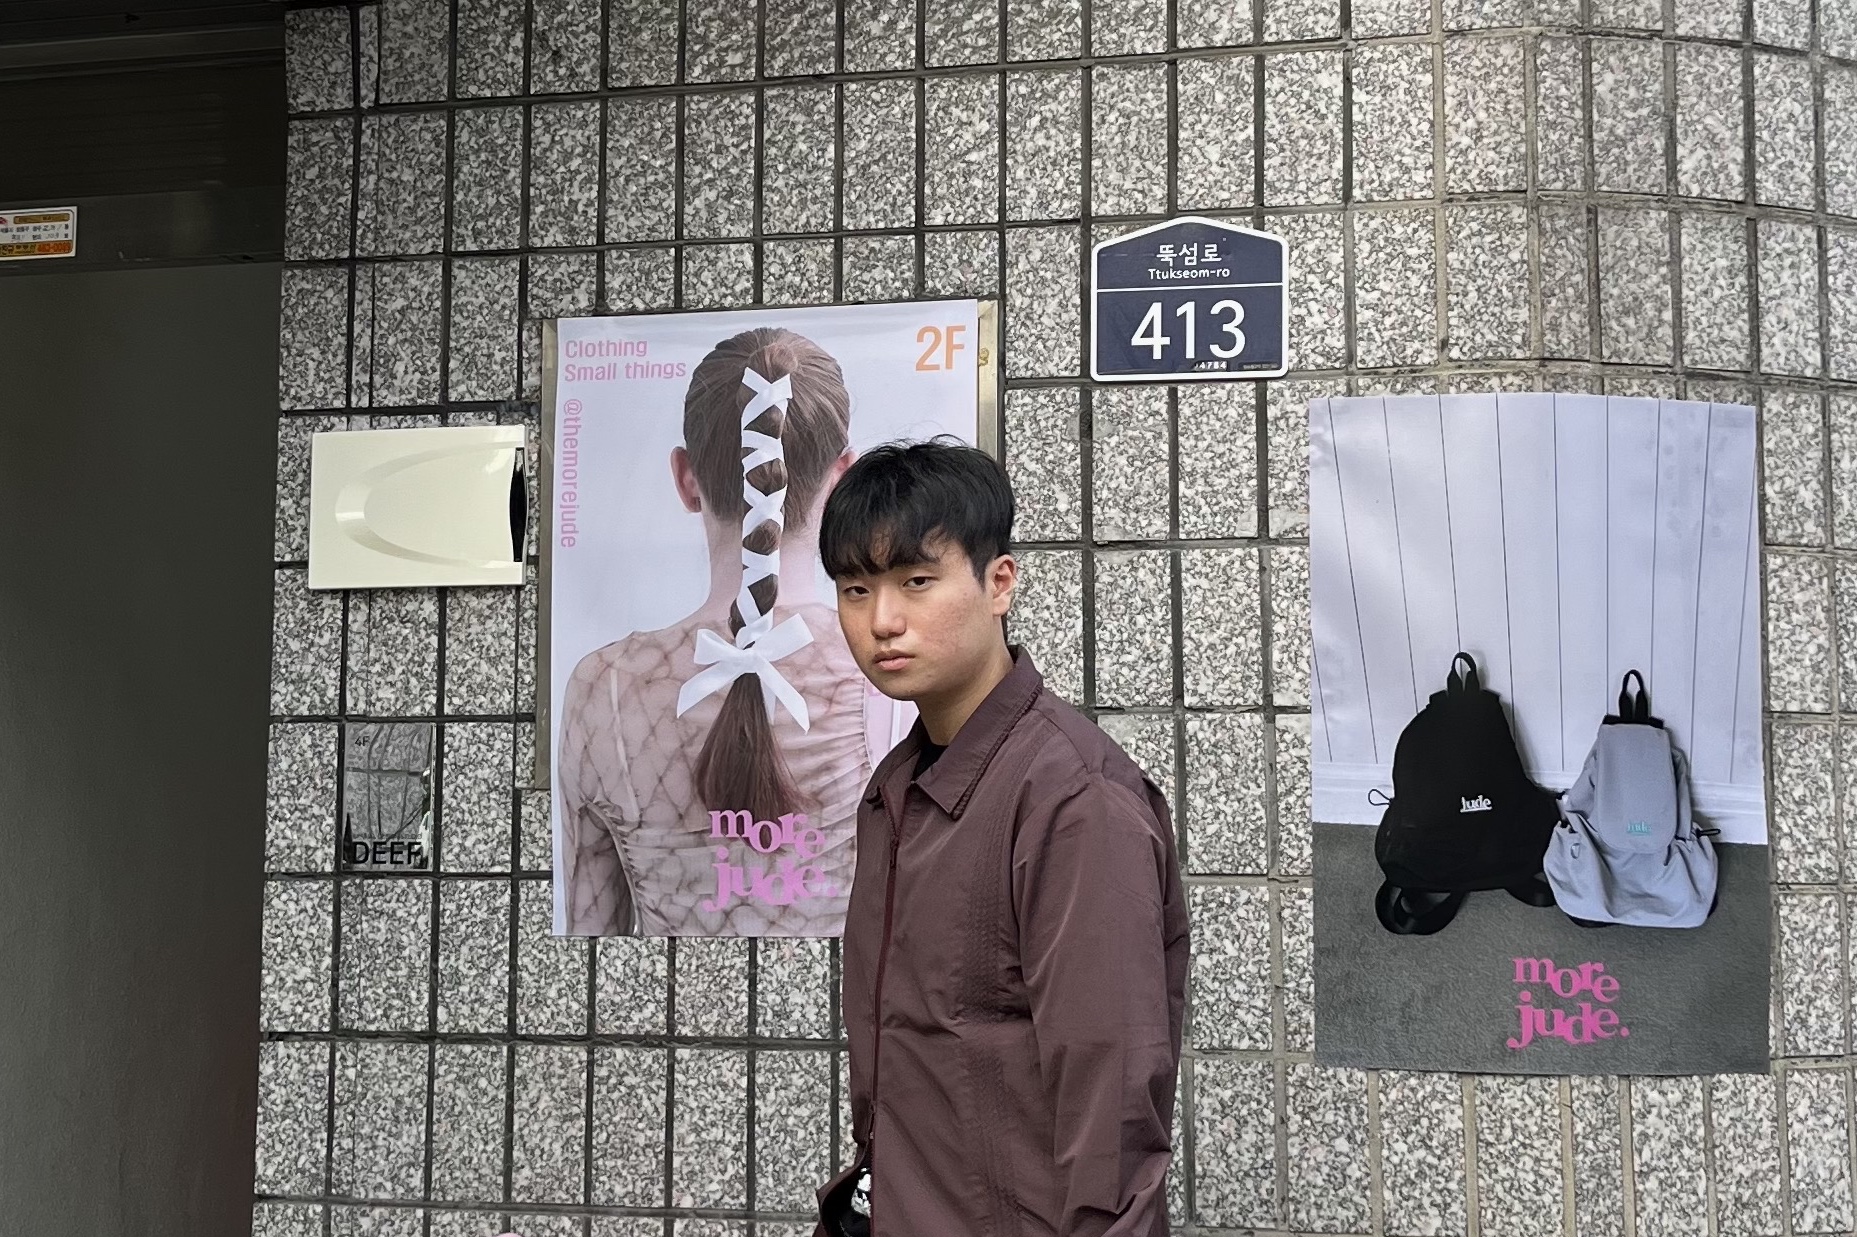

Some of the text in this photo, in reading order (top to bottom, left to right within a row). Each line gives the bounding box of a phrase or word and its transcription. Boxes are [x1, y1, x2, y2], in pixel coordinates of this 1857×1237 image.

[1148, 268, 1231, 280] Ttukseom-ro
[1156, 243, 1222, 267] 뚝섬로
[564, 339, 648, 359] Clothing
[915, 325, 967, 372] 2F
[1130, 299, 1246, 360] 413
[564, 361, 687, 382] Small things
[560, 399, 583, 548] @themorejude
[708, 809, 826, 859] more
[702, 846, 838, 912] jude.
[1511, 956, 1620, 1003] more
[1506, 991, 1630, 1049] jude.
